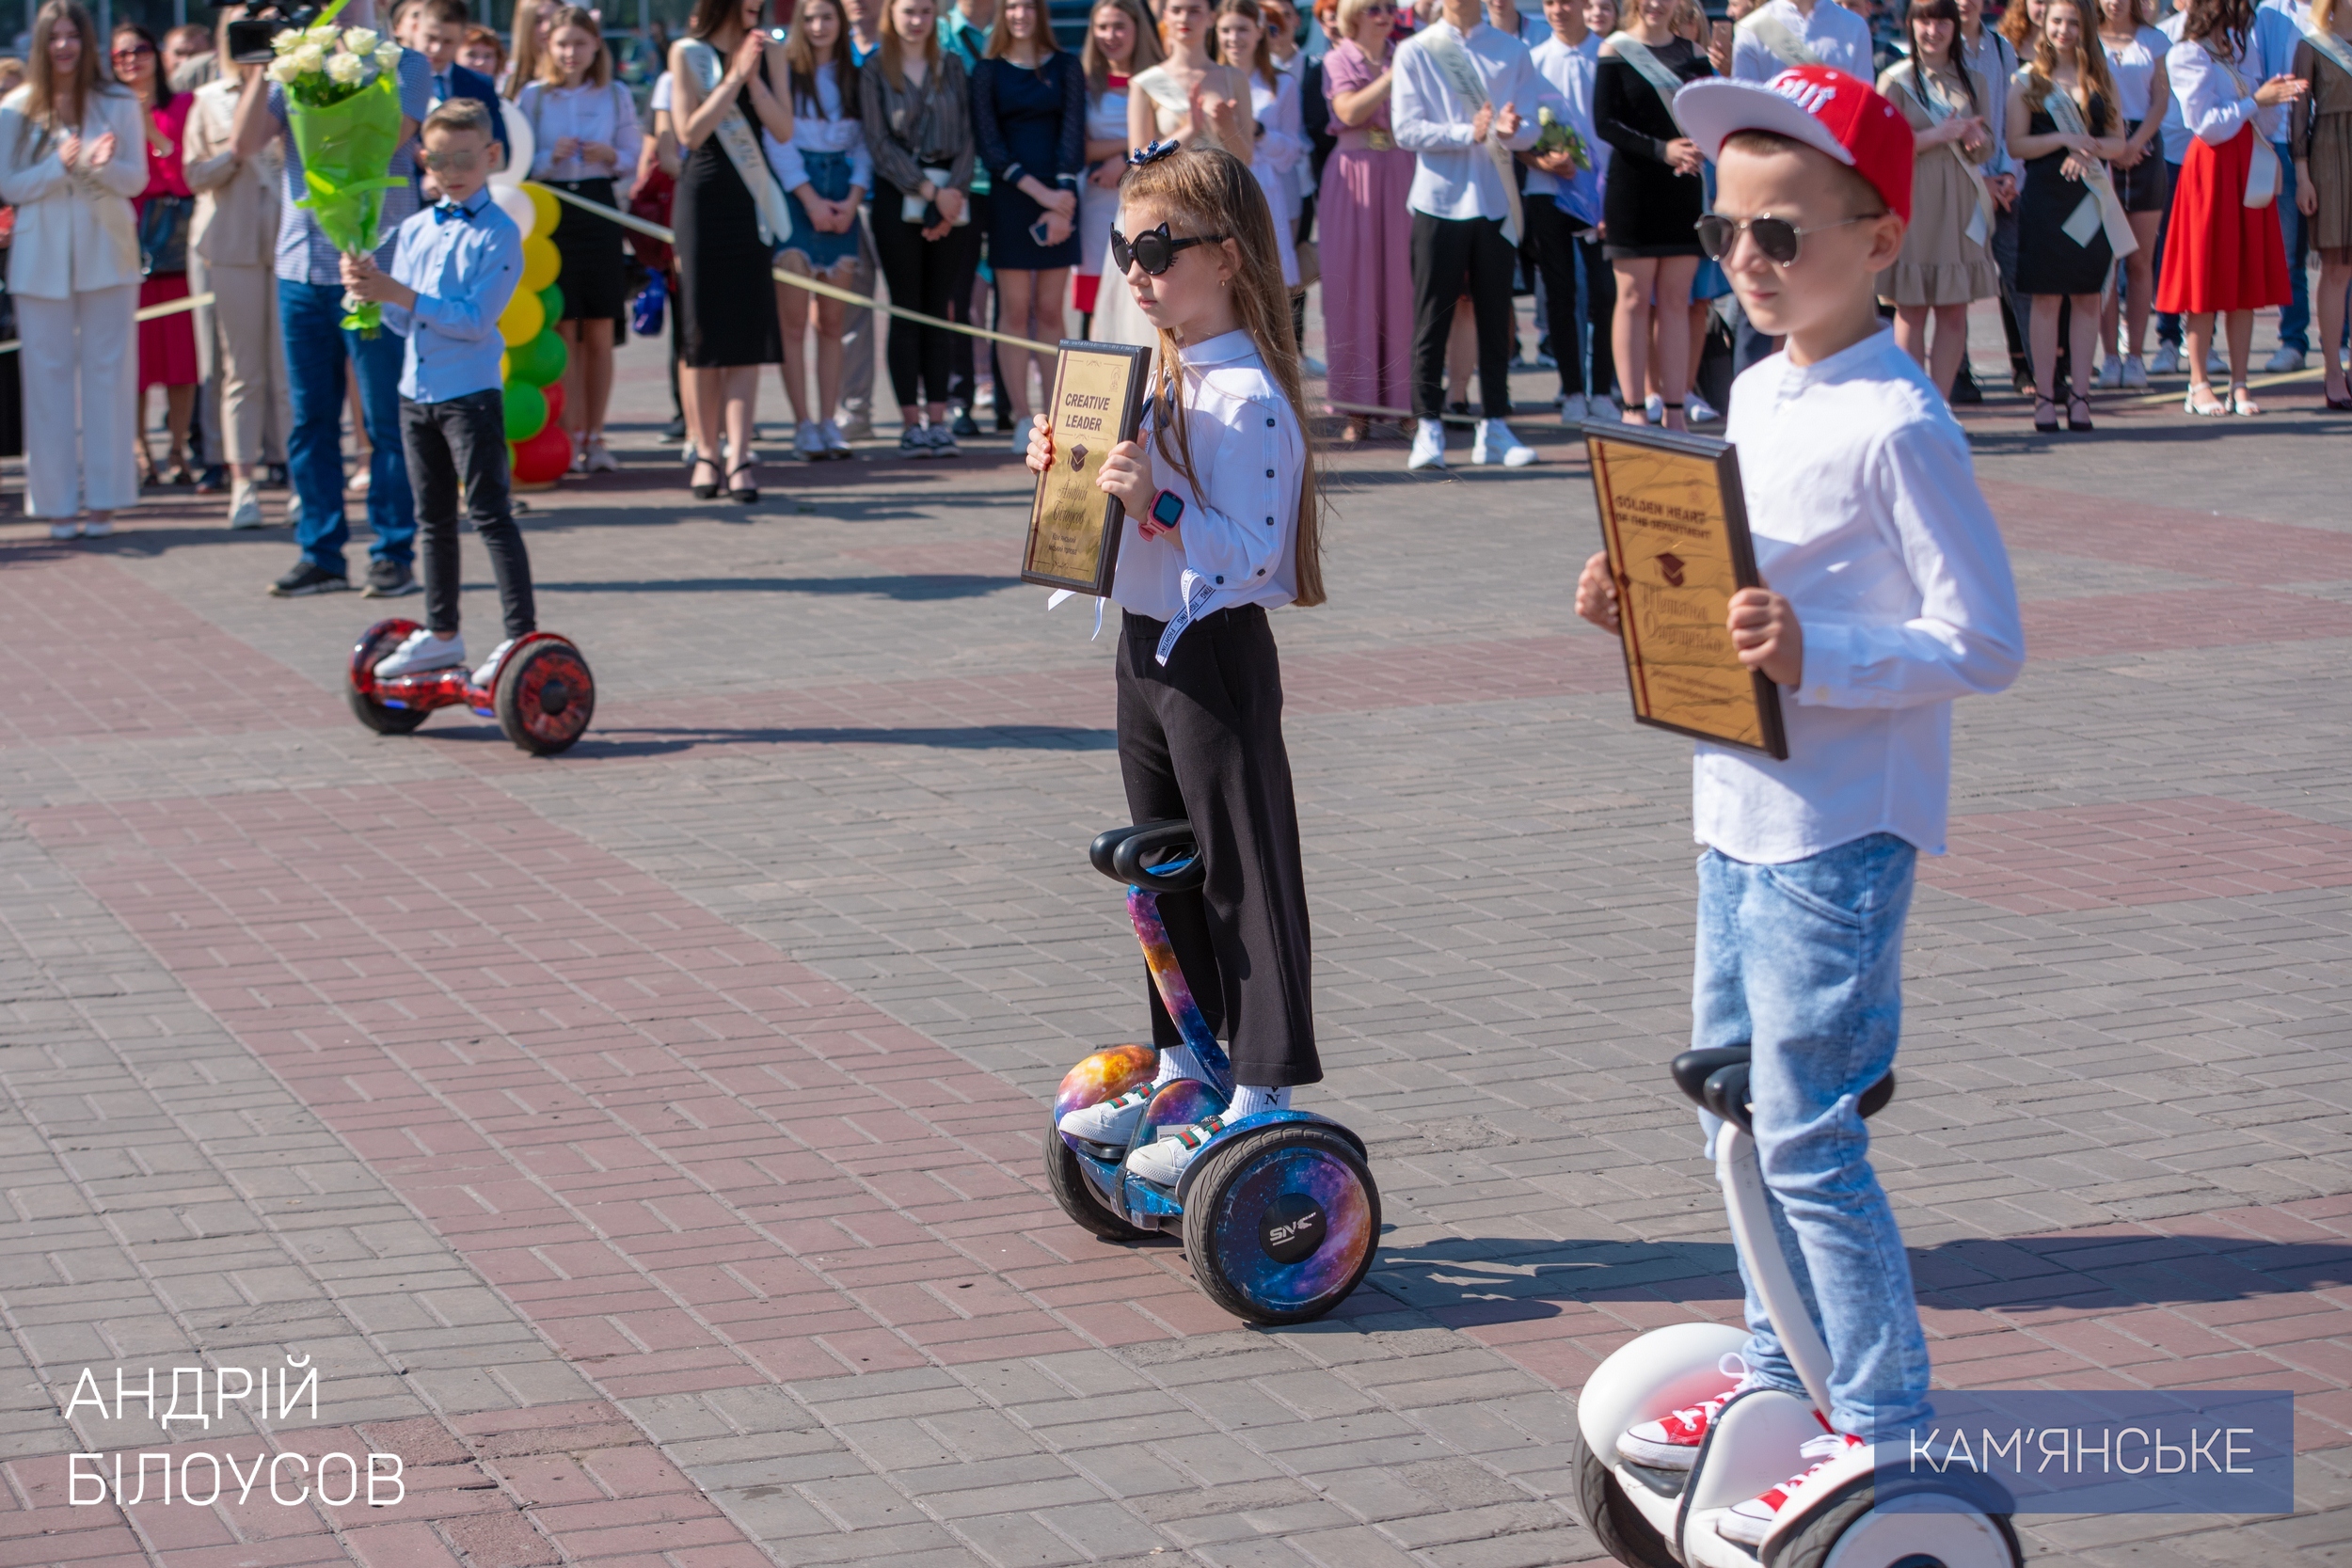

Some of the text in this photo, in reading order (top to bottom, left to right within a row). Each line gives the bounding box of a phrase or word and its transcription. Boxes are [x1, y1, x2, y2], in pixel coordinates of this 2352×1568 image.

[1065, 393, 1110, 411] CREATIVE
[1065, 414, 1102, 432] LEADER
[1057, 479, 1089, 507] Андрій
[1054, 500, 1086, 530] Білоусов
[1615, 496, 1706, 524] GOLDEN HEART
[1615, 513, 1711, 540] OF THE DEPARTMENT
[1160, 627, 1176, 657] FIGHTING
